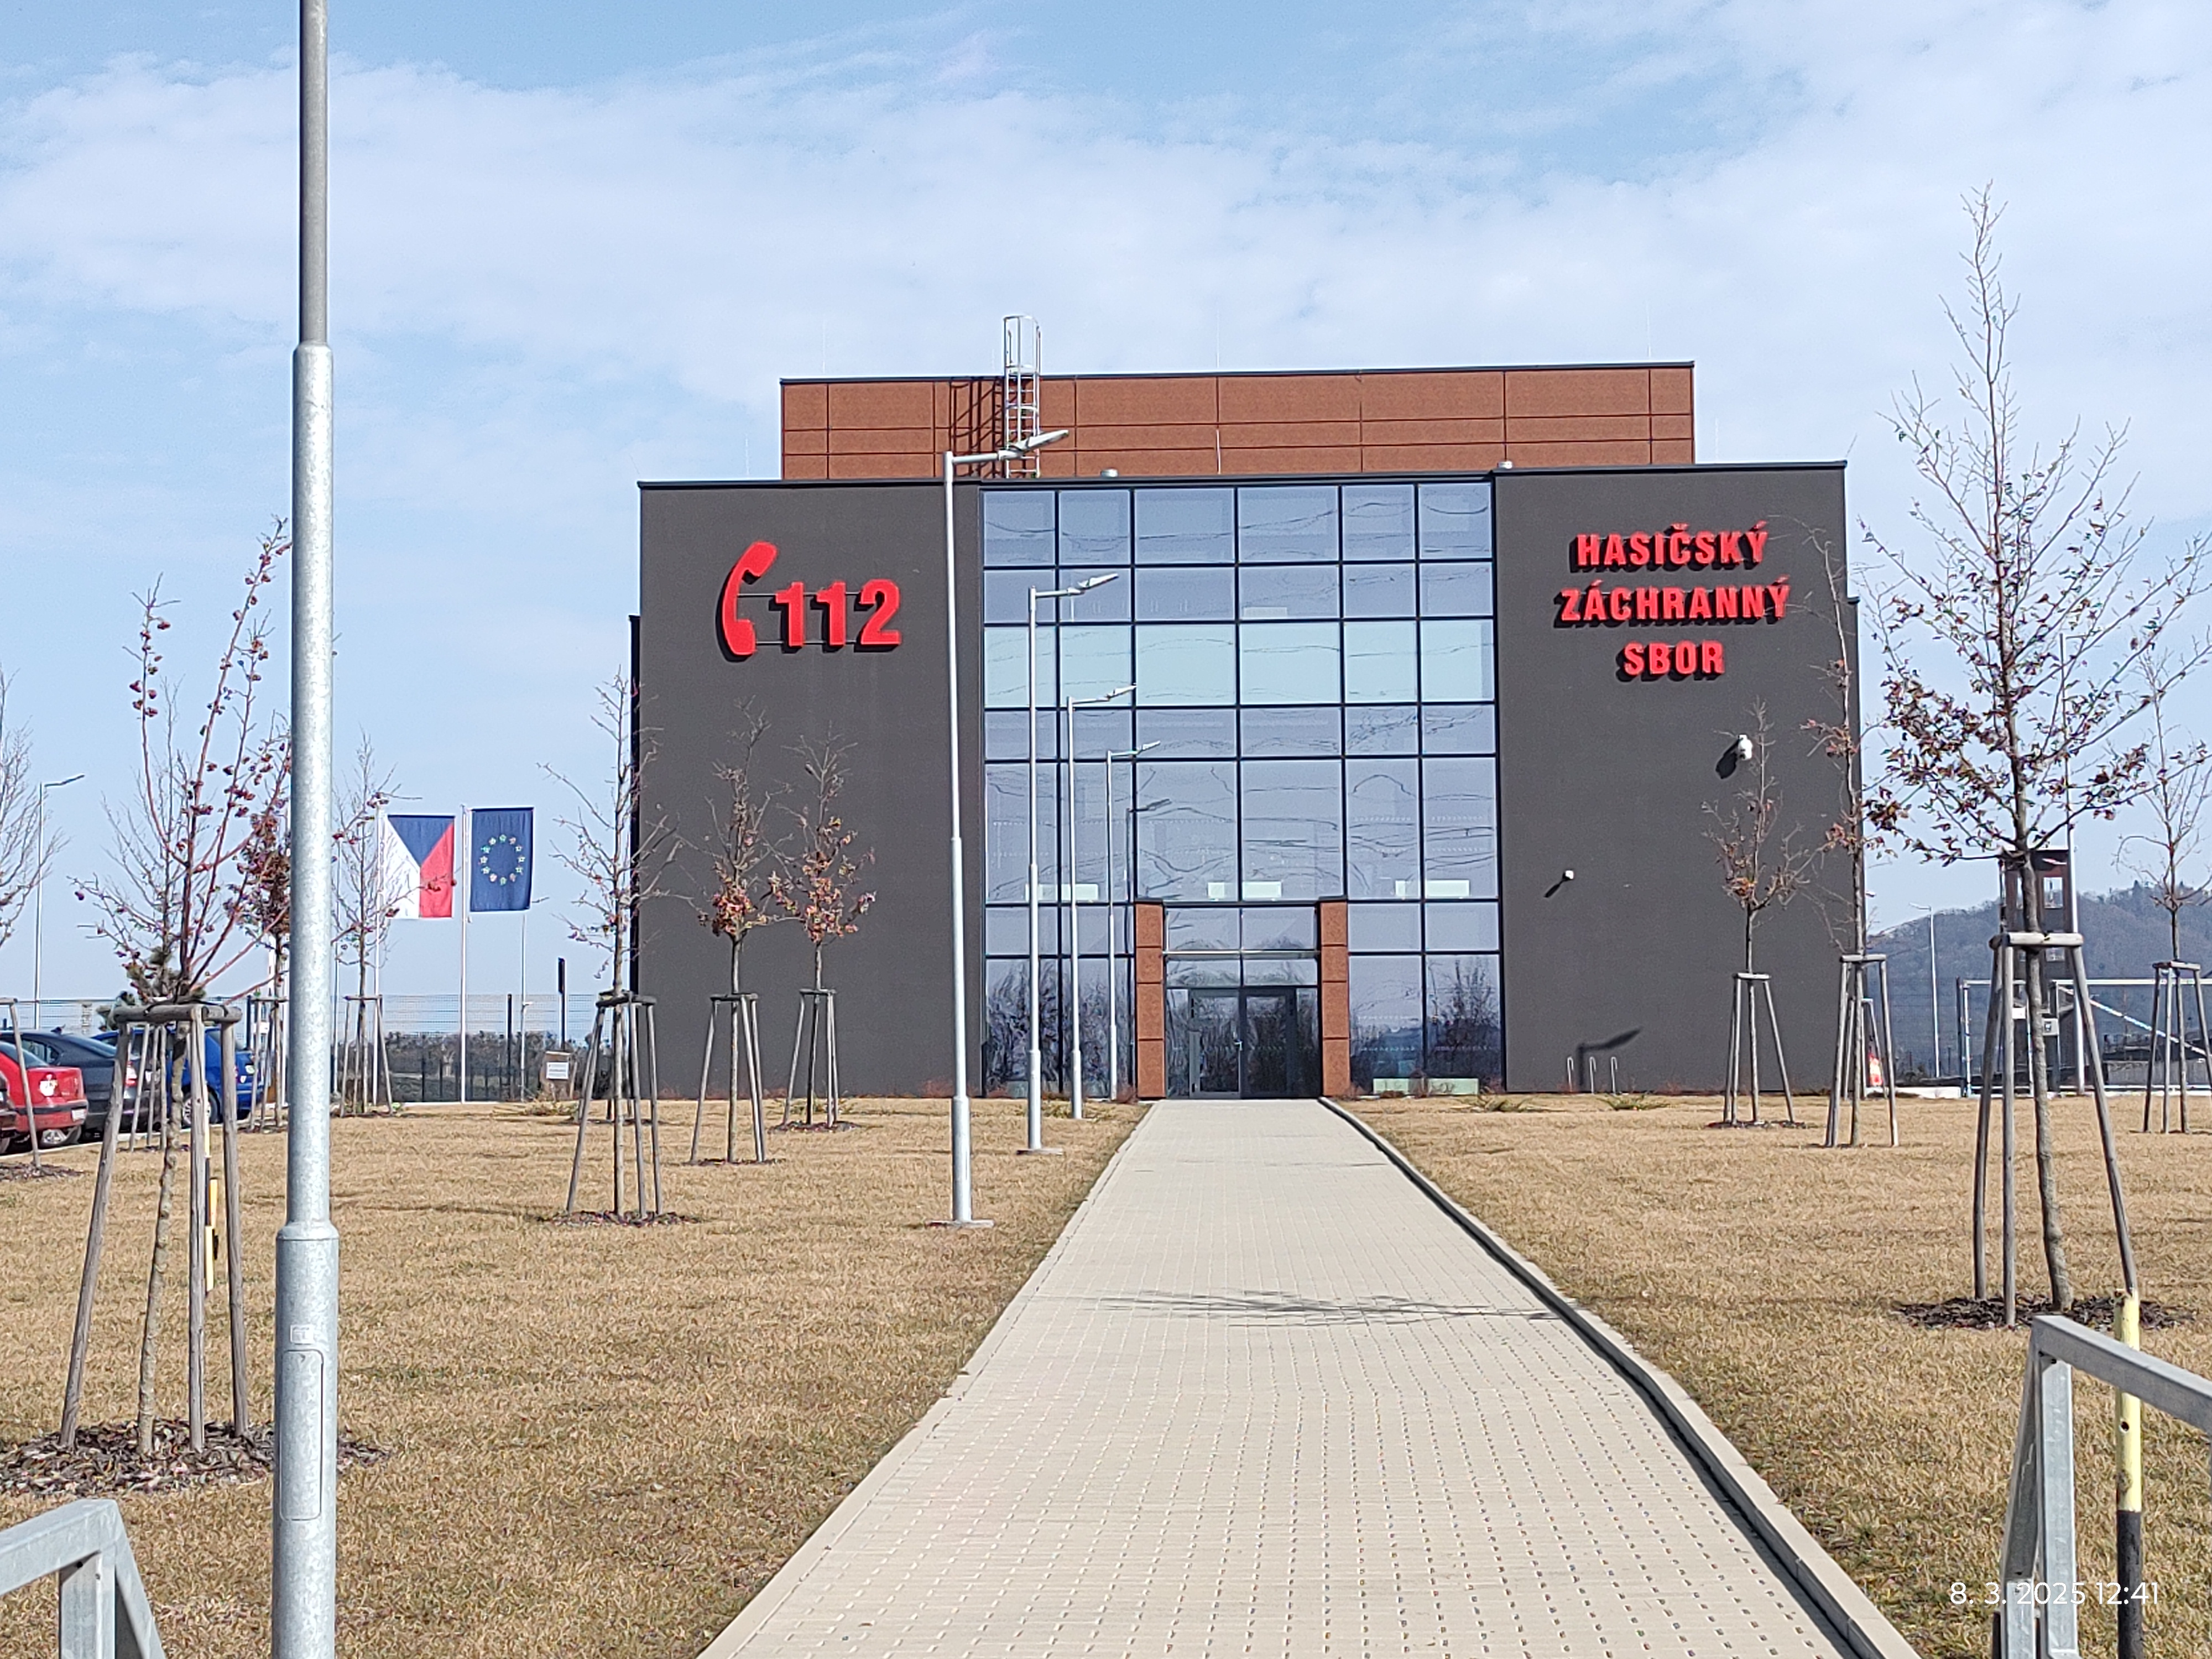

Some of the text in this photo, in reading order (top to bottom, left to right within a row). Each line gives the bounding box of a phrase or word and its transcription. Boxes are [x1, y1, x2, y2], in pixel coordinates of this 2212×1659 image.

[1575, 520, 1768, 566] HASIČSKÝ
[775, 579, 901, 646] 112
[1559, 575, 1790, 621] ZÁCHRANNÝ
[1623, 641, 1725, 676] SBOR
